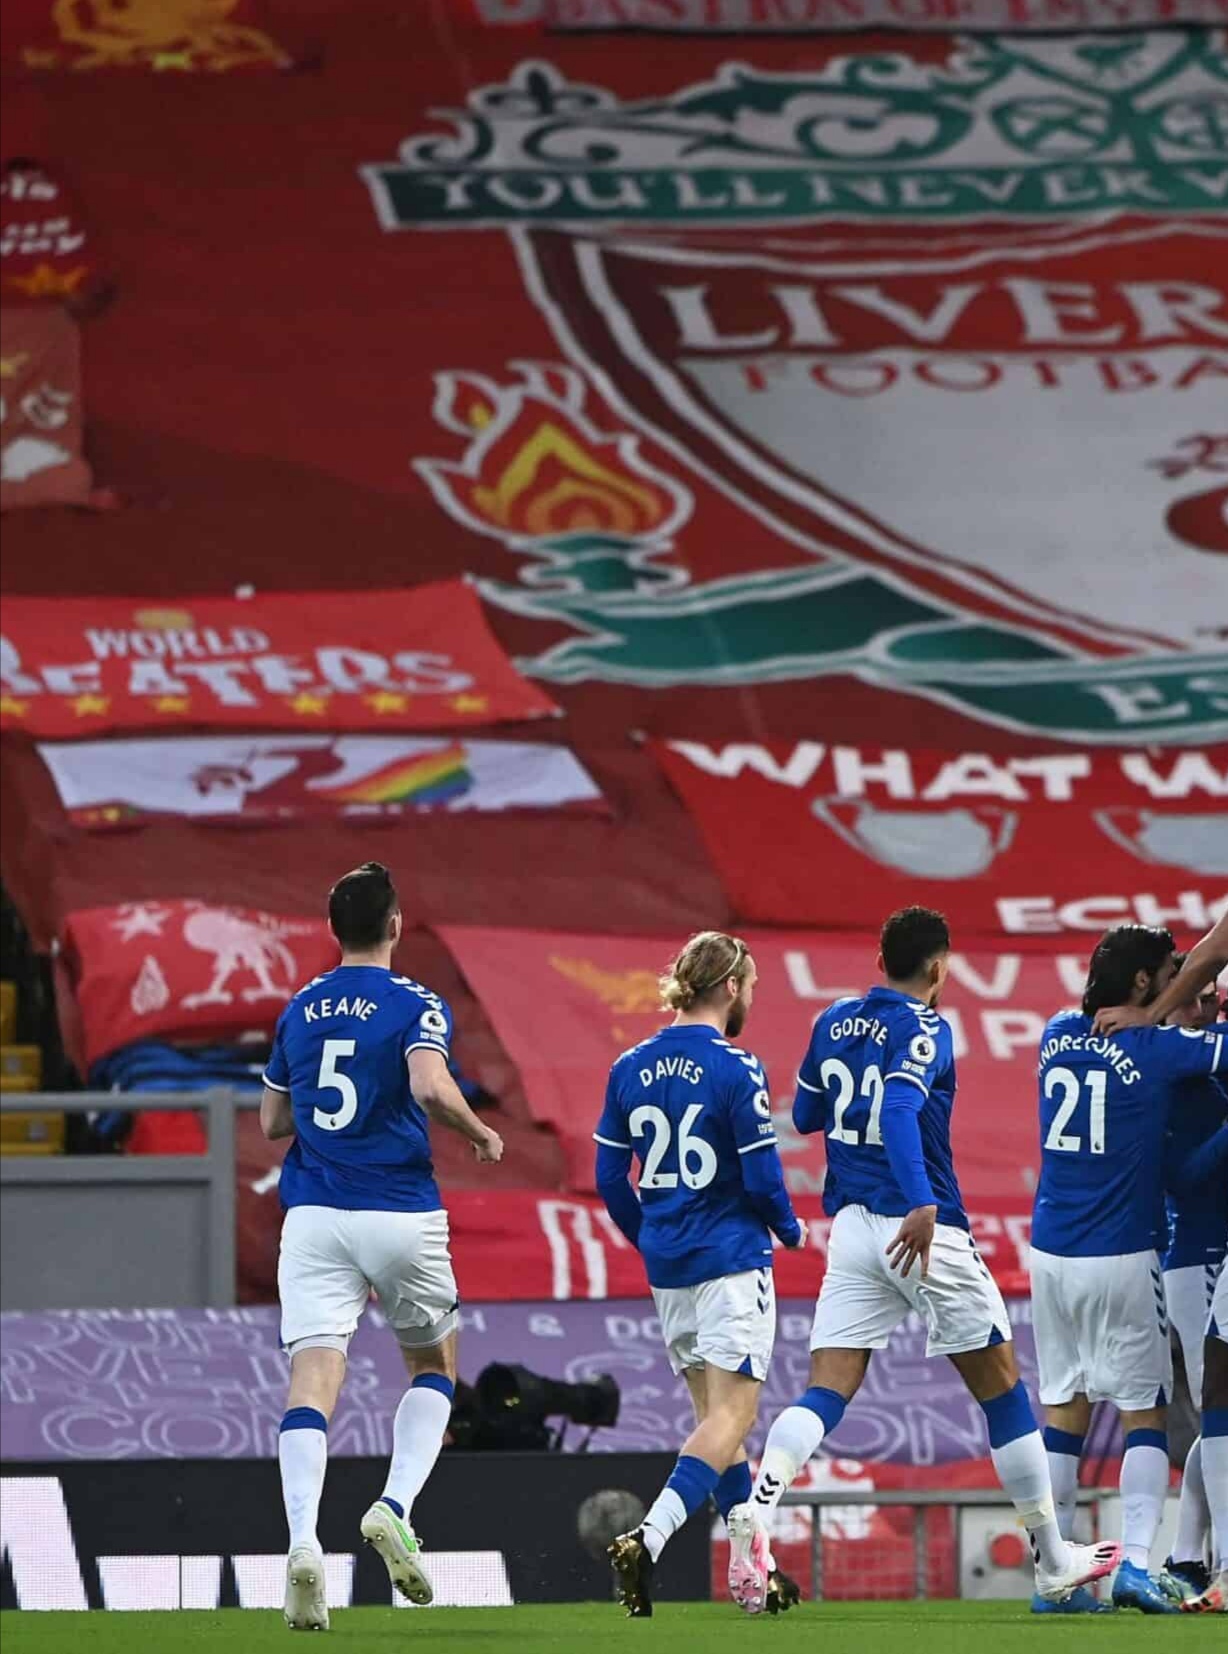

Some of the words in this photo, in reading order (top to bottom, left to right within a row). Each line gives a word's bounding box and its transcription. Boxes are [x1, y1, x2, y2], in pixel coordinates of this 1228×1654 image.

[807, 166, 1170, 206] NEVER
[85, 627, 270, 659] WORLD
[664, 738, 1090, 800] WHAT
[303, 995, 379, 1024] KEANE
[312, 1038, 359, 1132] 5
[639, 1056, 704, 1088] DAVIES
[820, 1057, 885, 1146] 22
[1043, 1066, 1107, 1155] 21
[628, 1103, 718, 1190] 26
